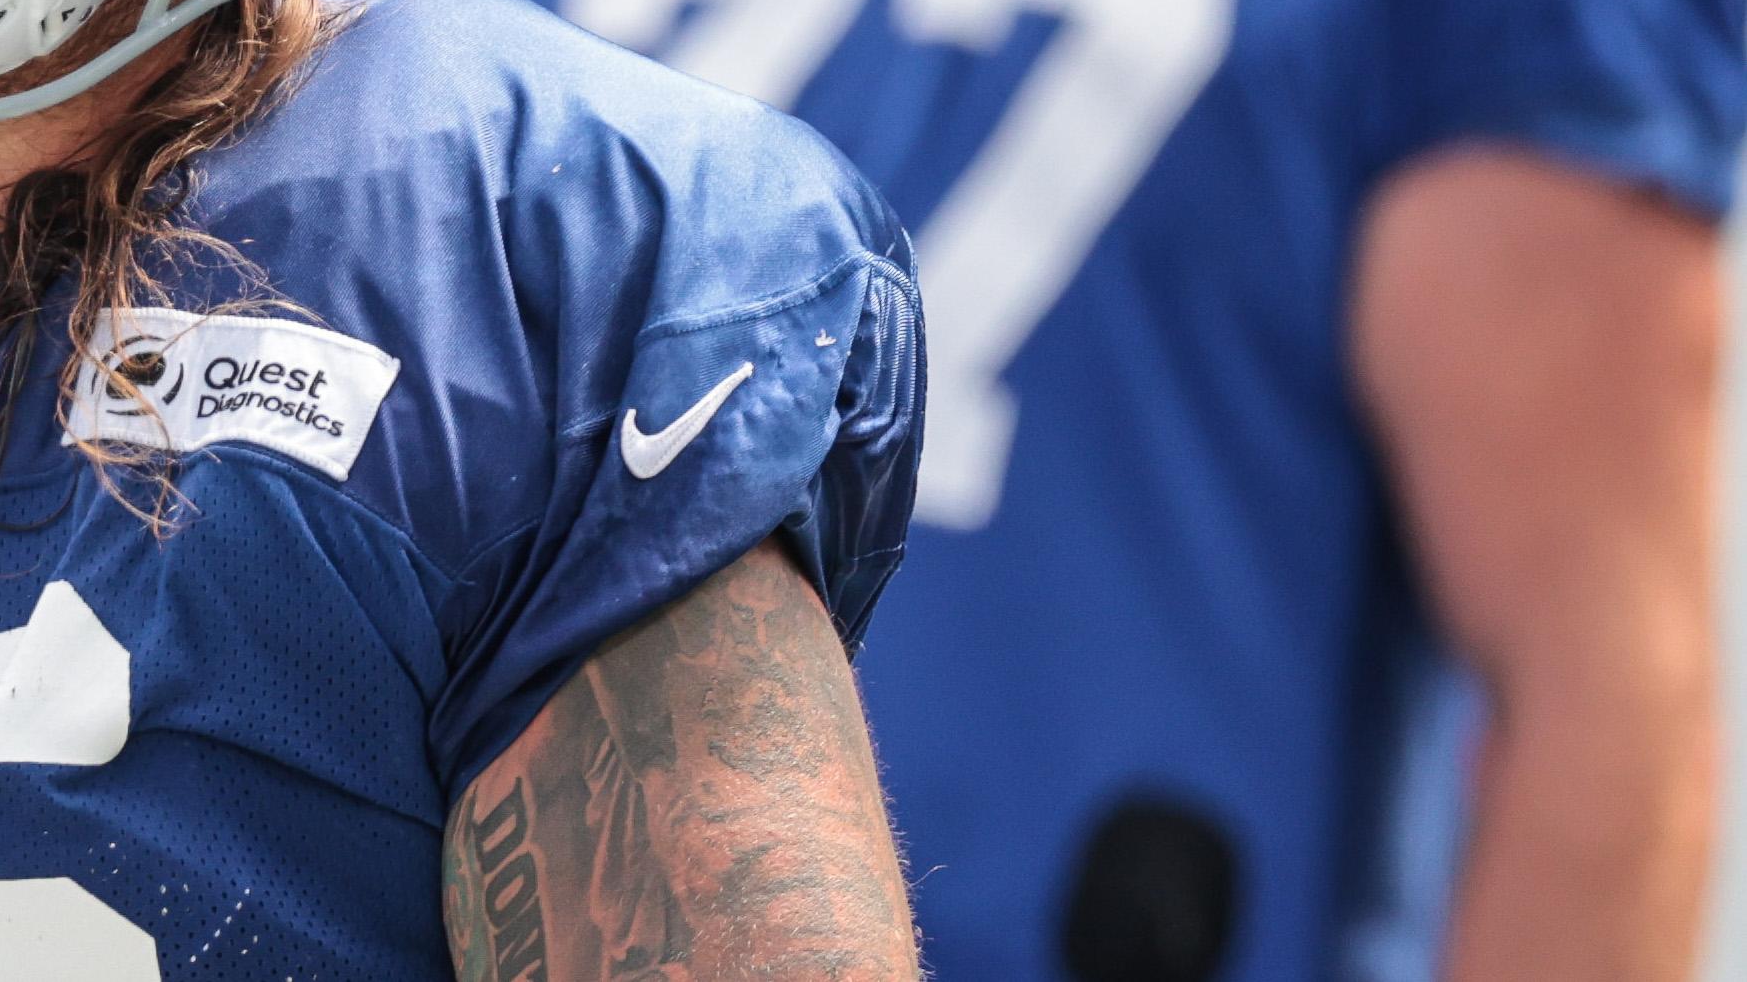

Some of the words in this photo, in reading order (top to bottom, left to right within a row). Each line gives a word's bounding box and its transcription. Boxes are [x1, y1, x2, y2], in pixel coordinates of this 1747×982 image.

[203, 356, 330, 400] Quest
[197, 391, 344, 438] Diagnostics
[473, 776, 548, 982] DON
